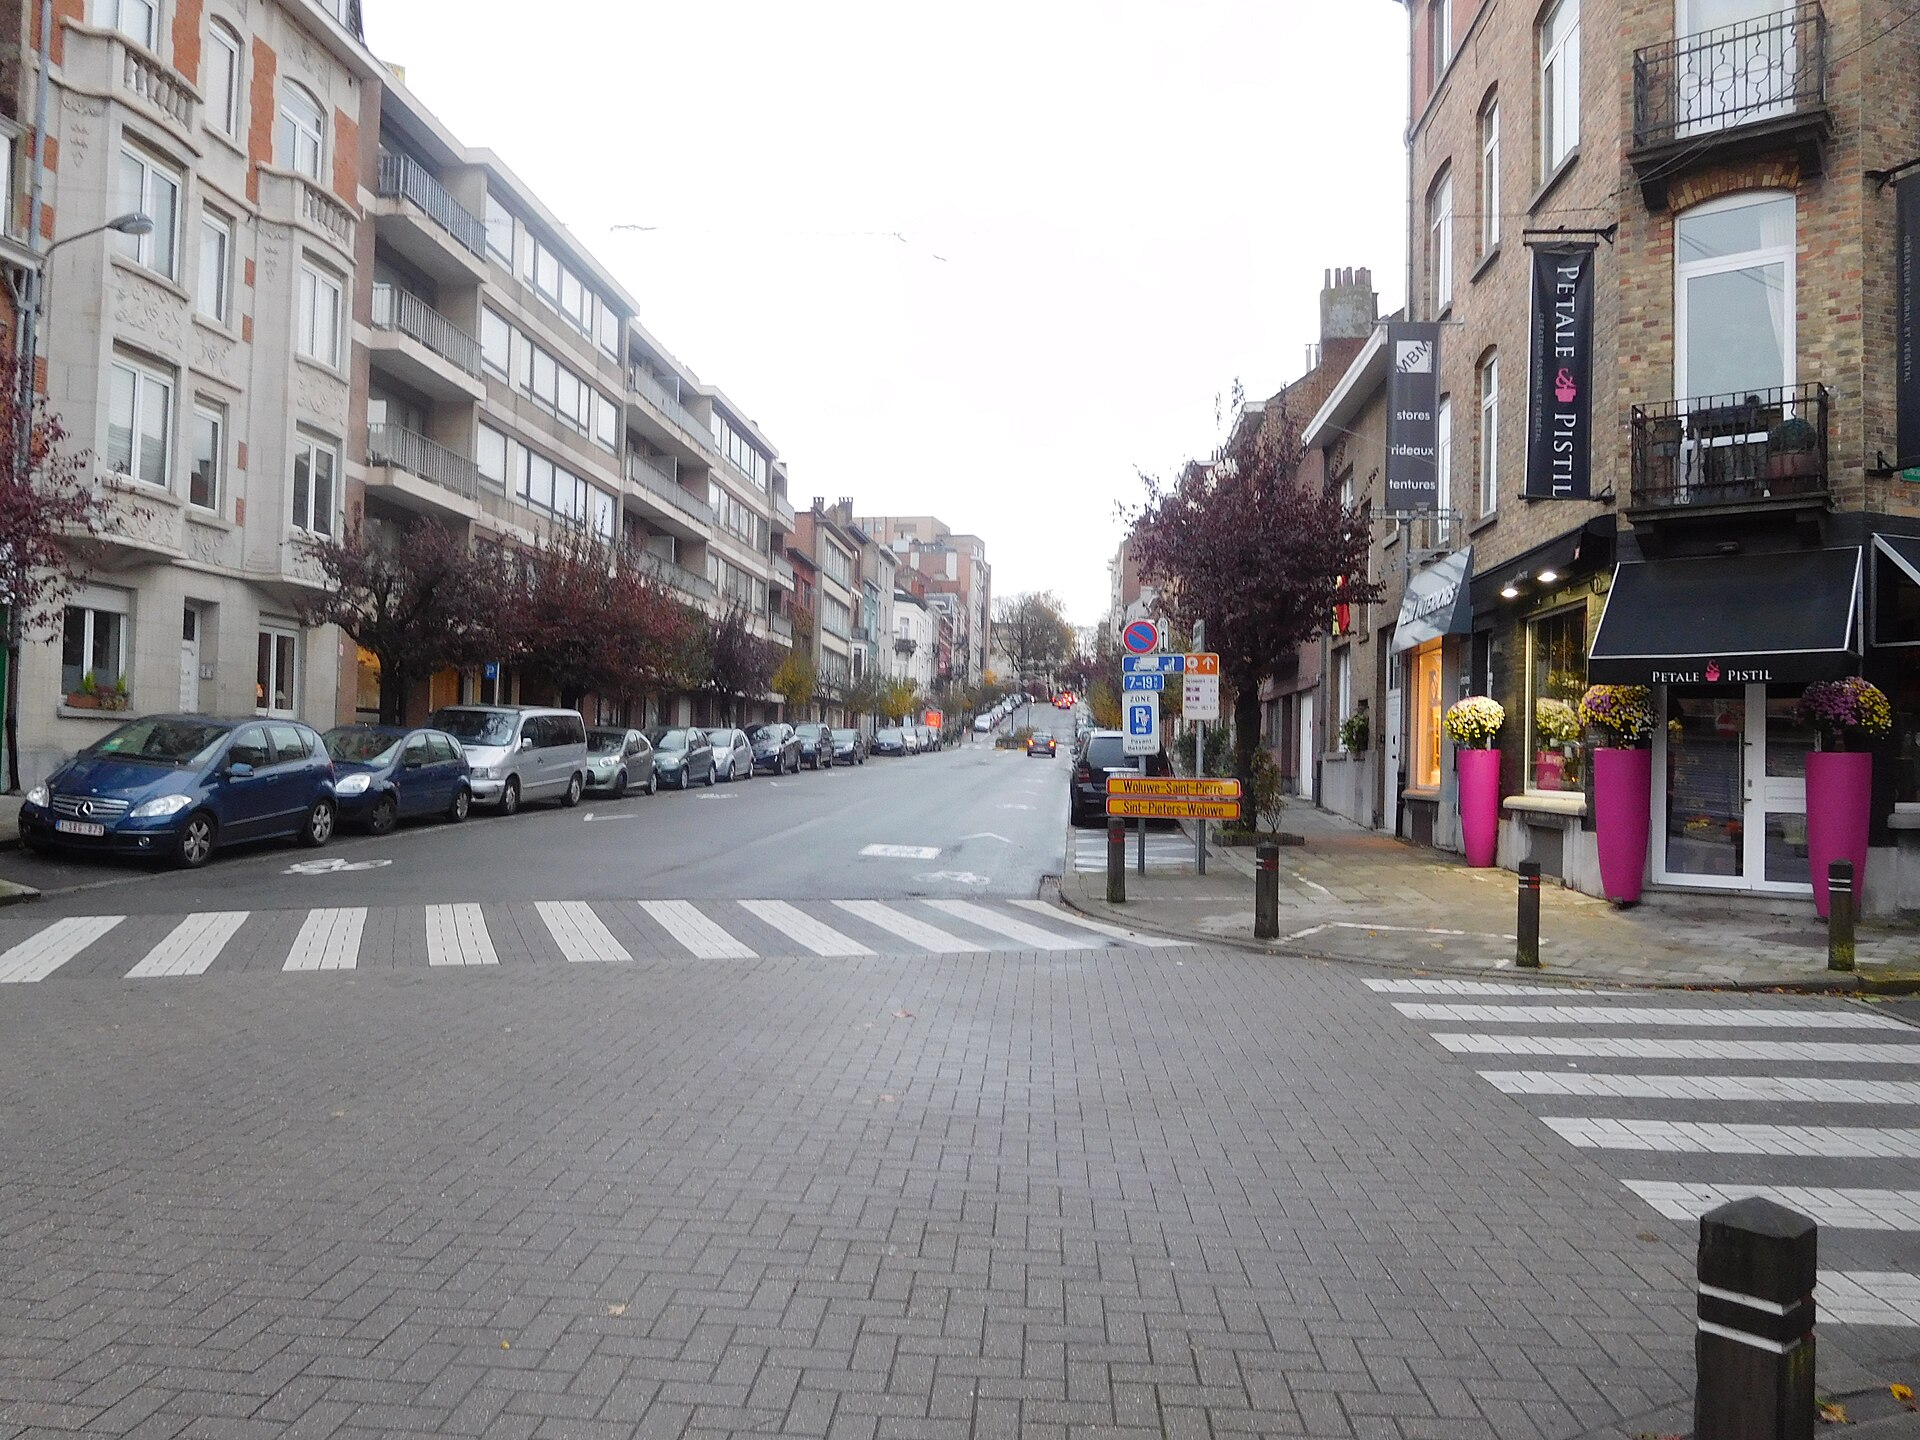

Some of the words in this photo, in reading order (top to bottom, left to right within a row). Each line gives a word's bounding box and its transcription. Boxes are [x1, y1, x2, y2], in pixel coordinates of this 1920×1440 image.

[1556, 266, 1580, 358] PETALE
[1397, 340, 1429, 373] MBM
[1396, 409, 1431, 421] stores
[1391, 444, 1434, 456] rideaux
[1553, 412, 1577, 497] PISTIL
[1389, 479, 1436, 490] tentures
[1652, 671, 1699, 682] PETALE
[1728, 669, 1772, 681] PISTIL
[1129, 676, 1152, 689] 7-19
[1130, 695, 1151, 703] ZONE
[1123, 780, 1224, 794] Woluwe-Saint-Pierre
[1123, 801, 1224, 817] Sint-Pieters-Woluwe
